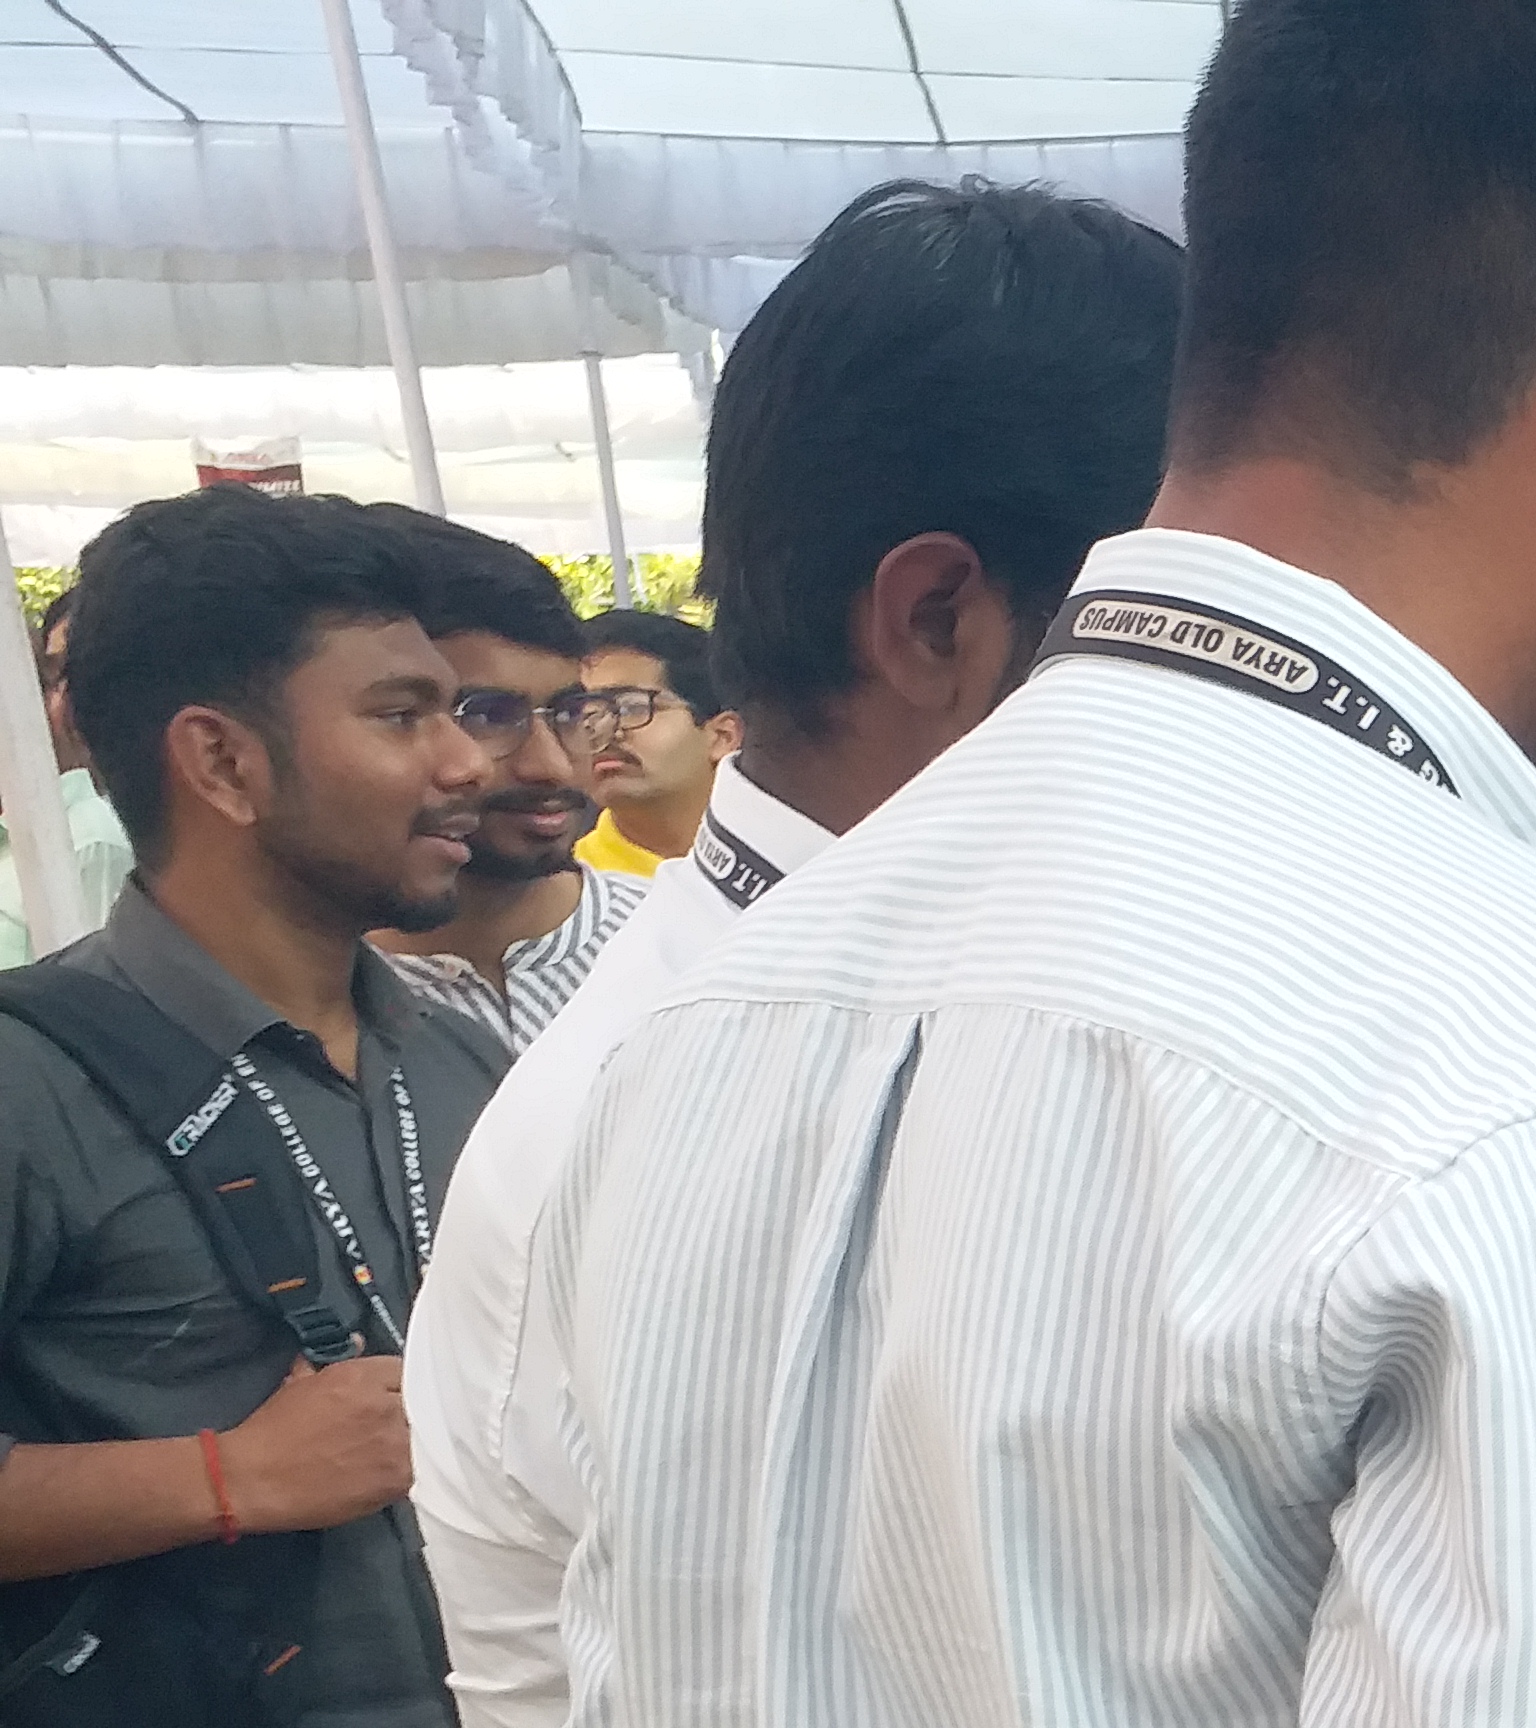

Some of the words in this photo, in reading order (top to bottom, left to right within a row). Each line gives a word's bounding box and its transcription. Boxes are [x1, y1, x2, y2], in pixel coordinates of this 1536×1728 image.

[1078, 606, 1167, 639] CAMPUS
[1170, 618, 1226, 654] OLD
[1231, 634, 1310, 685] ARYA
[1322, 675, 1382, 732] I.T.
[1386, 723, 1414, 757] &
[730, 862, 769, 900] I.T.
